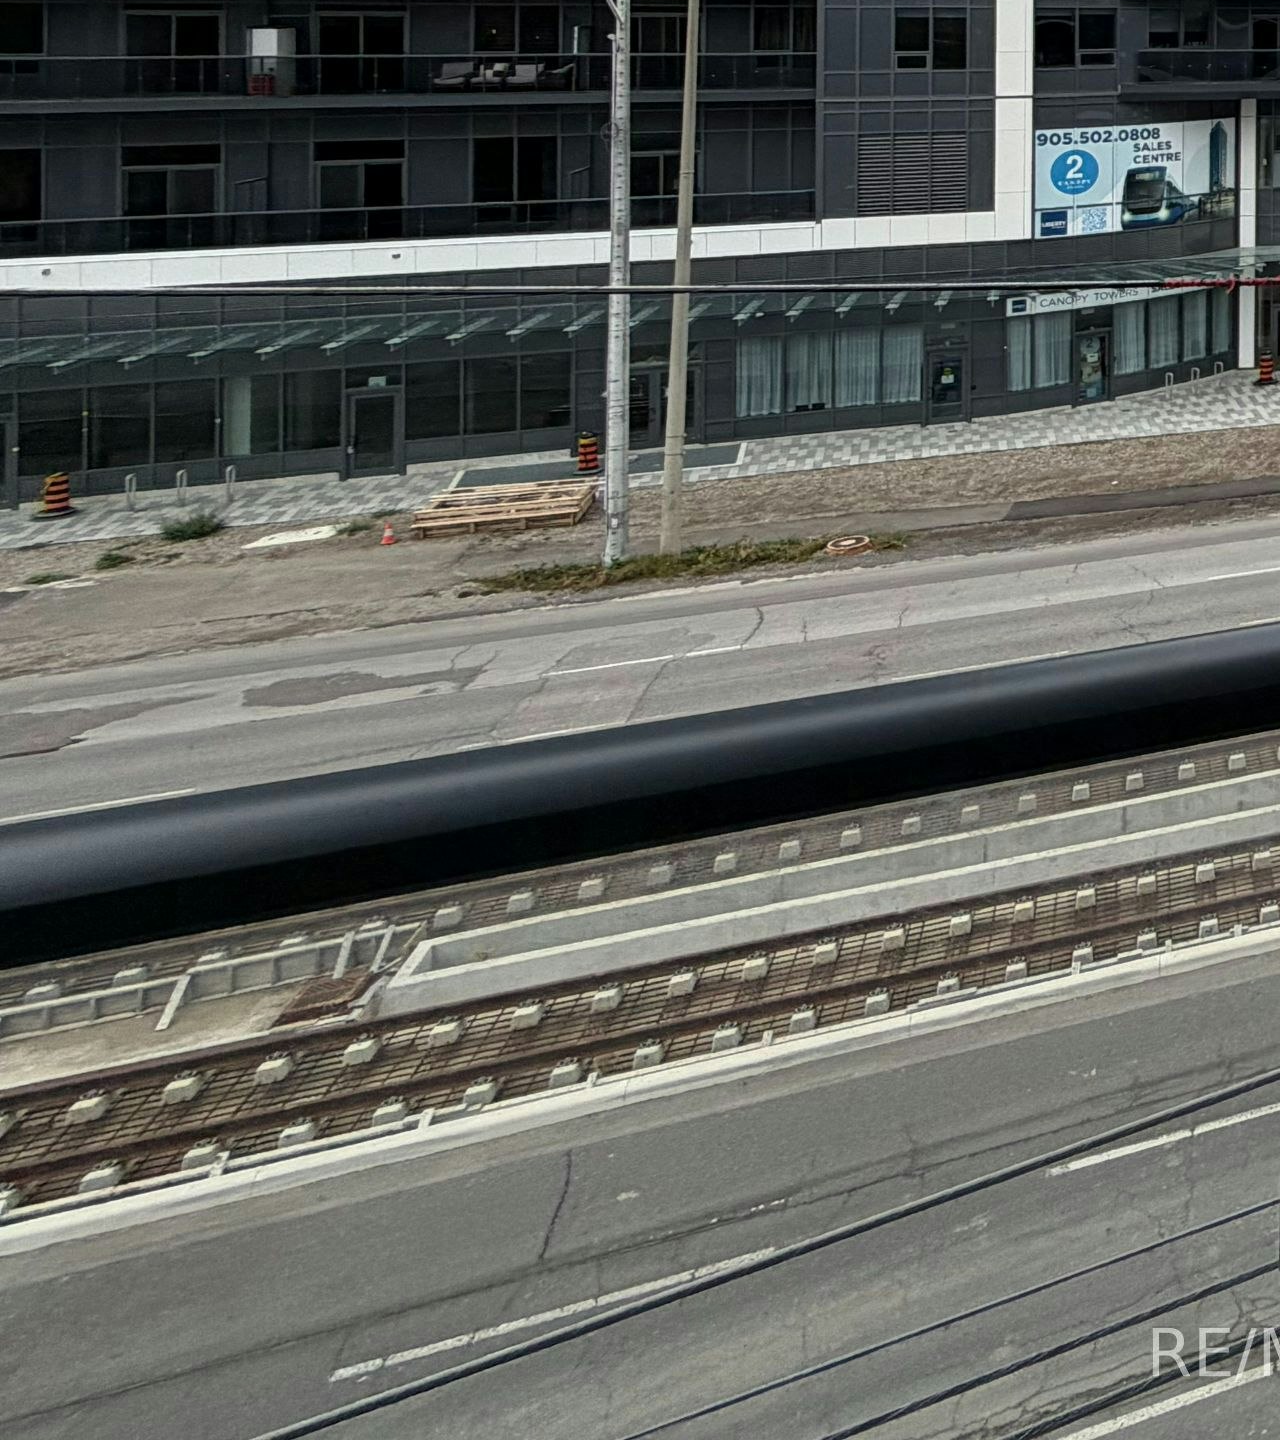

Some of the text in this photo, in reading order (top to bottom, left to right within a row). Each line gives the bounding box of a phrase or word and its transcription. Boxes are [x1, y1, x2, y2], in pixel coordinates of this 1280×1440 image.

[1036, 127, 1161, 146] 905.502.0808
[1133, 141, 1172, 152] SALES
[1066, 154, 1084, 179] 2
[1133, 152, 1182, 164] CENTRE
[1040, 293, 1089, 308] CANOPY
[1095, 287, 1139, 302] TOWERS
